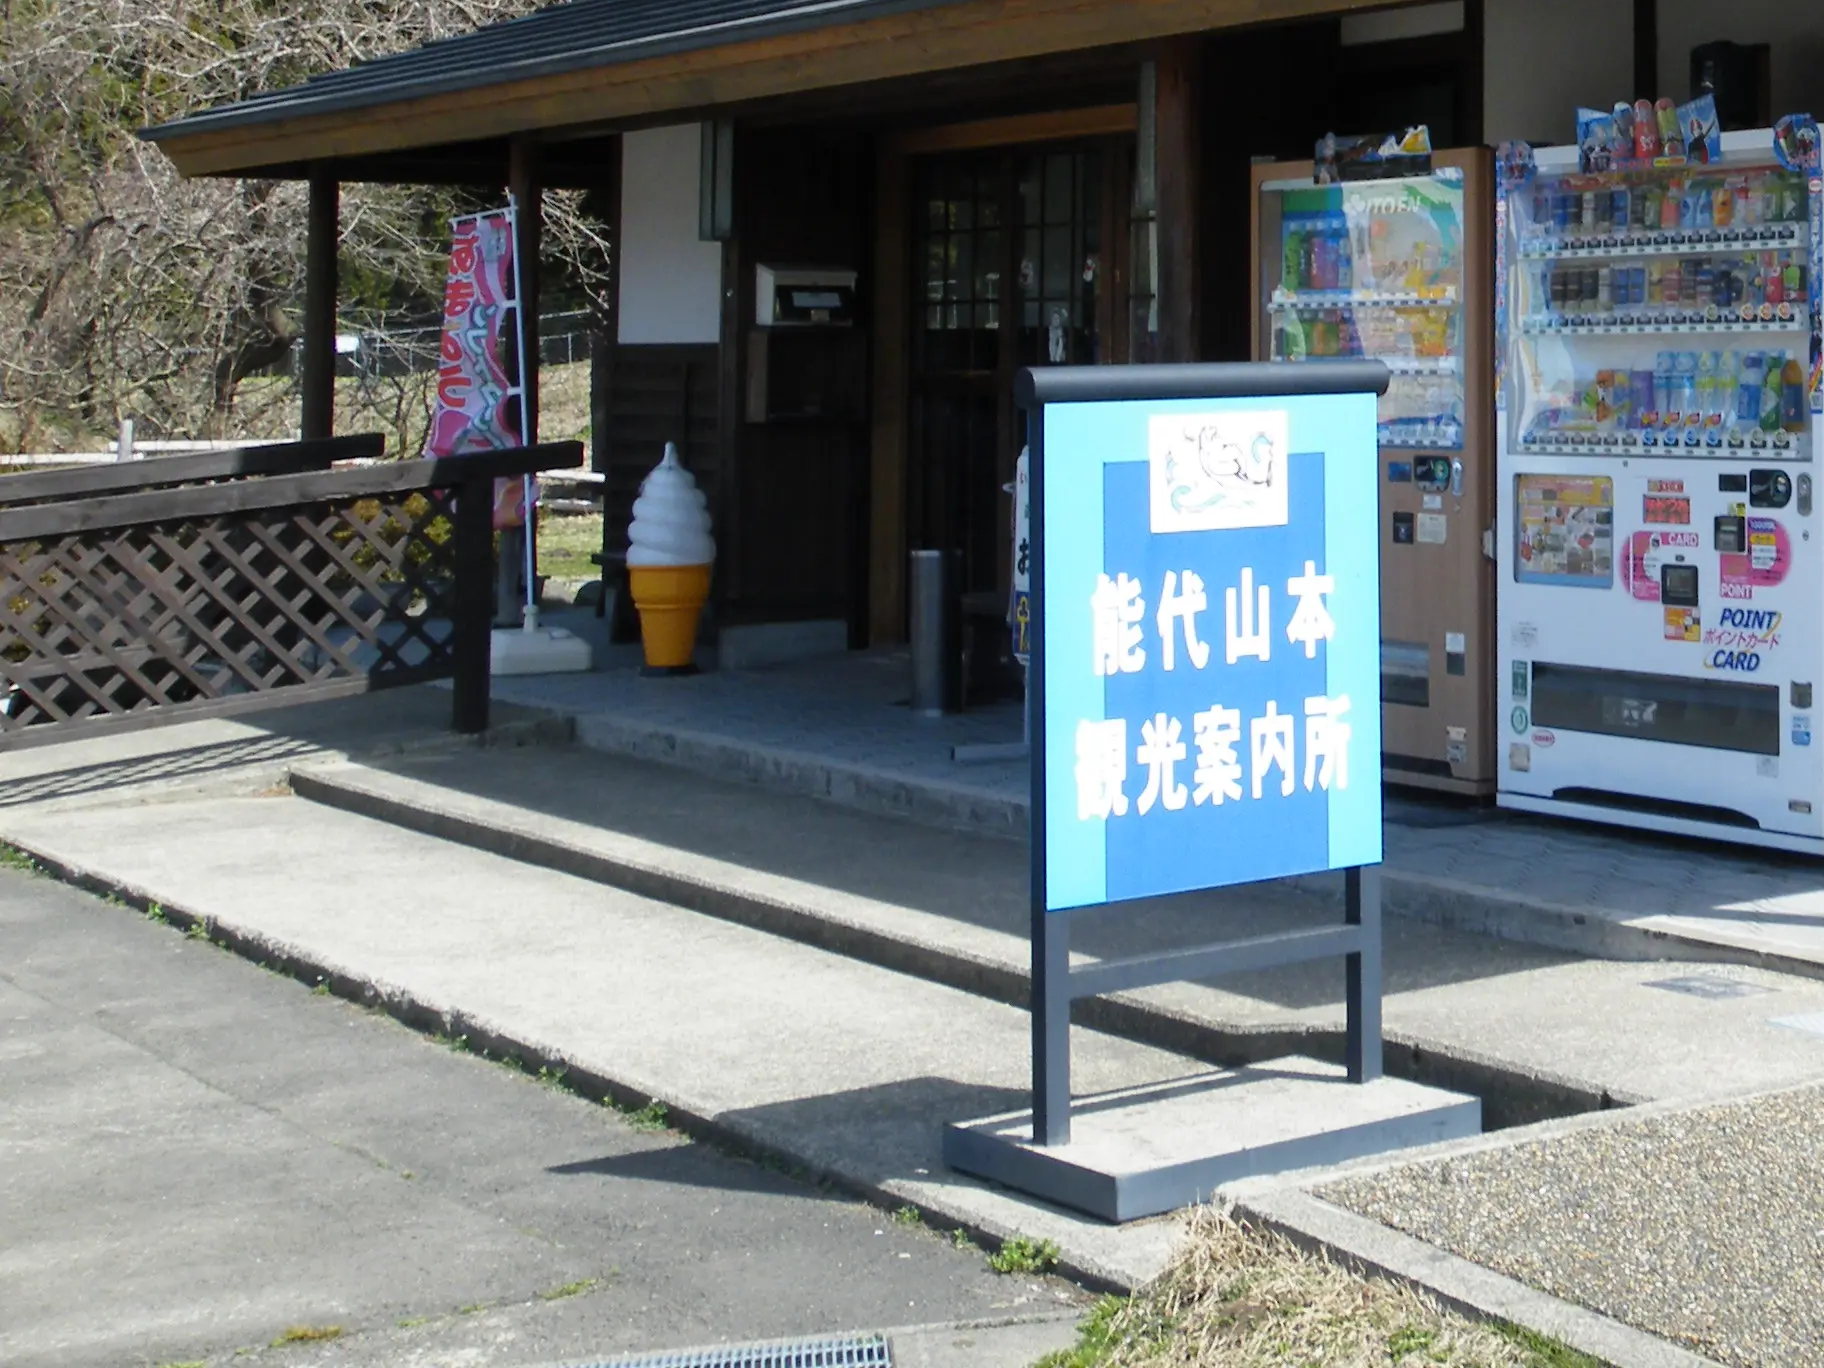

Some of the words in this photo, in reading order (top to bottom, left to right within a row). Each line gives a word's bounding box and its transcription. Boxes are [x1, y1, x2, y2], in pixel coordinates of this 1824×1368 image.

[1668, 532, 1698, 547] CARD
[1090, 560, 1336, 676] 能代山本
[1719, 608, 1777, 631] POINT
[1703, 628, 1781, 650] ポイントカード
[1713, 649, 1760, 671] CARD
[1075, 693, 1353, 821] 観光案内所
